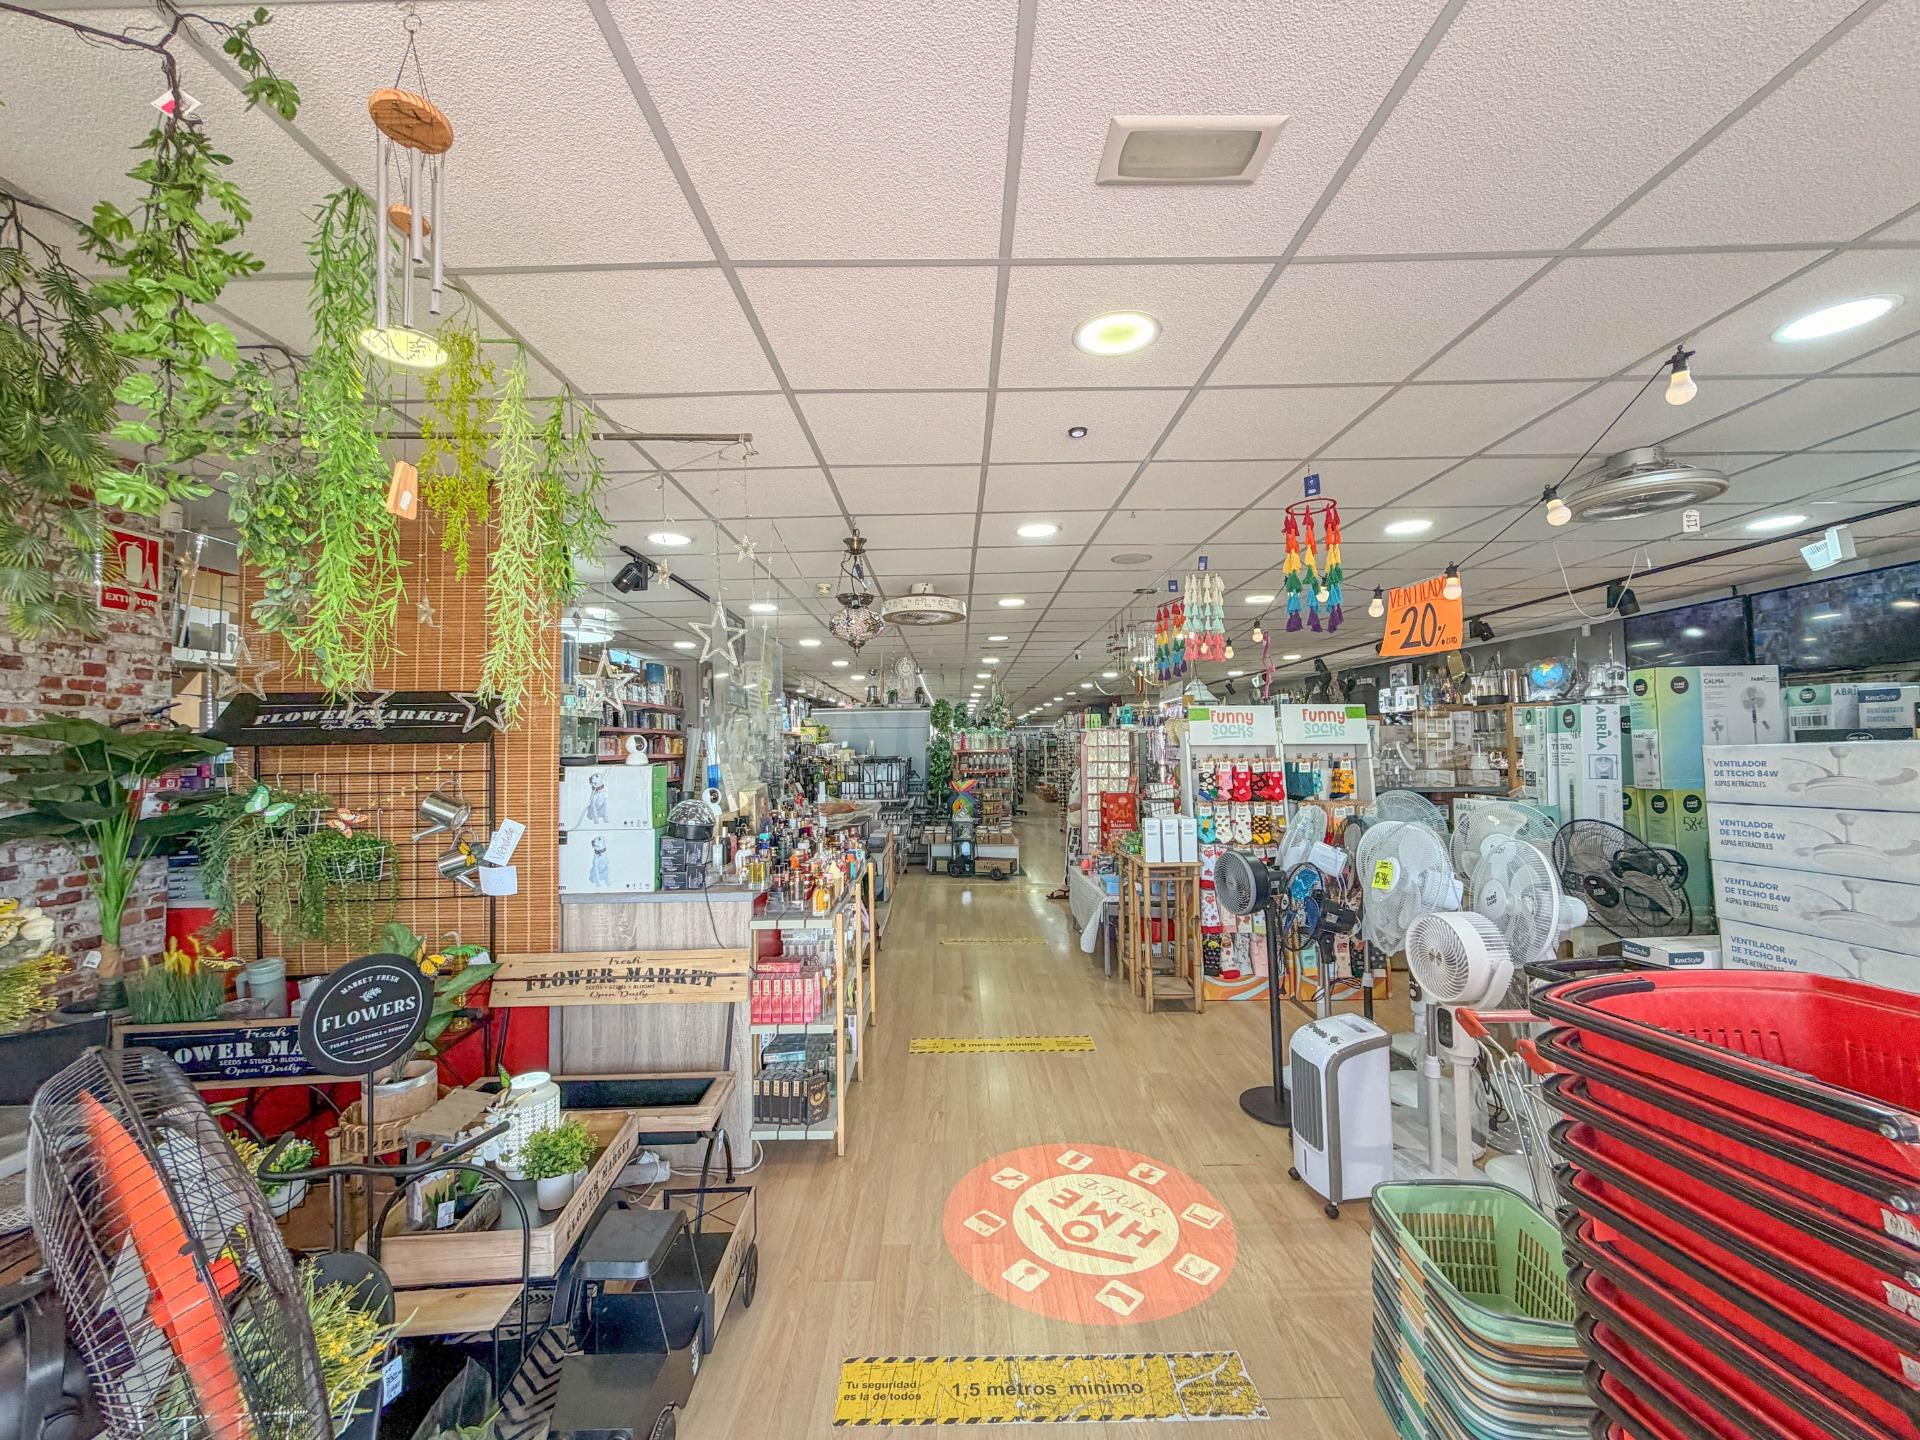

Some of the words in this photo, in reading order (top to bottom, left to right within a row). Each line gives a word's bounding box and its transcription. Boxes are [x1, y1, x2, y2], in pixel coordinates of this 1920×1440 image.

[105, 592, 154, 607] EXTITOR
[1210, 710, 1254, 725] Funny
[1302, 708, 1345, 724] Funny
[1713, 760, 1767, 768] VENTILADOR
[1713, 769, 1724, 777] DE
[1719, 819, 1774, 829] VENTILADOR
[1720, 828, 1731, 836] DE
[1732, 830, 1761, 838] TECHO
[1763, 832, 1786, 840] 84W
[1724, 876, 1779, 891] VENTILADOR
[1725, 886, 1736, 895] DE
[1738, 888, 1767, 899] TECHO
[1769, 893, 1791, 903] 84W
[1730, 936, 1785, 953] VENTILADOR
[1731, 945, 1742, 954] DE
[1744, 948, 1774, 961] TECHO
[1775, 953, 1798, 966] 84W
[340, 976, 374, 996] MARKET
[376, 974, 401, 984] FRESH
[525, 968, 617, 992] FLOWER
[623, 966, 717, 988] MARKET
[321, 996, 417, 1033] FLOWERS
[239, 1027, 290, 1040] Fresh
[173, 1042, 254, 1065] OWER
[846, 1380, 859, 1390] Tu
[862, 1380, 918, 1391] seguridad
[952, 1383, 981, 1399] 1,5
[986, 1382, 1057, 1397] metros
[860, 1392, 870, 1401] la
[872, 1392, 887, 1401] de
[889, 1392, 922, 1402] todos
